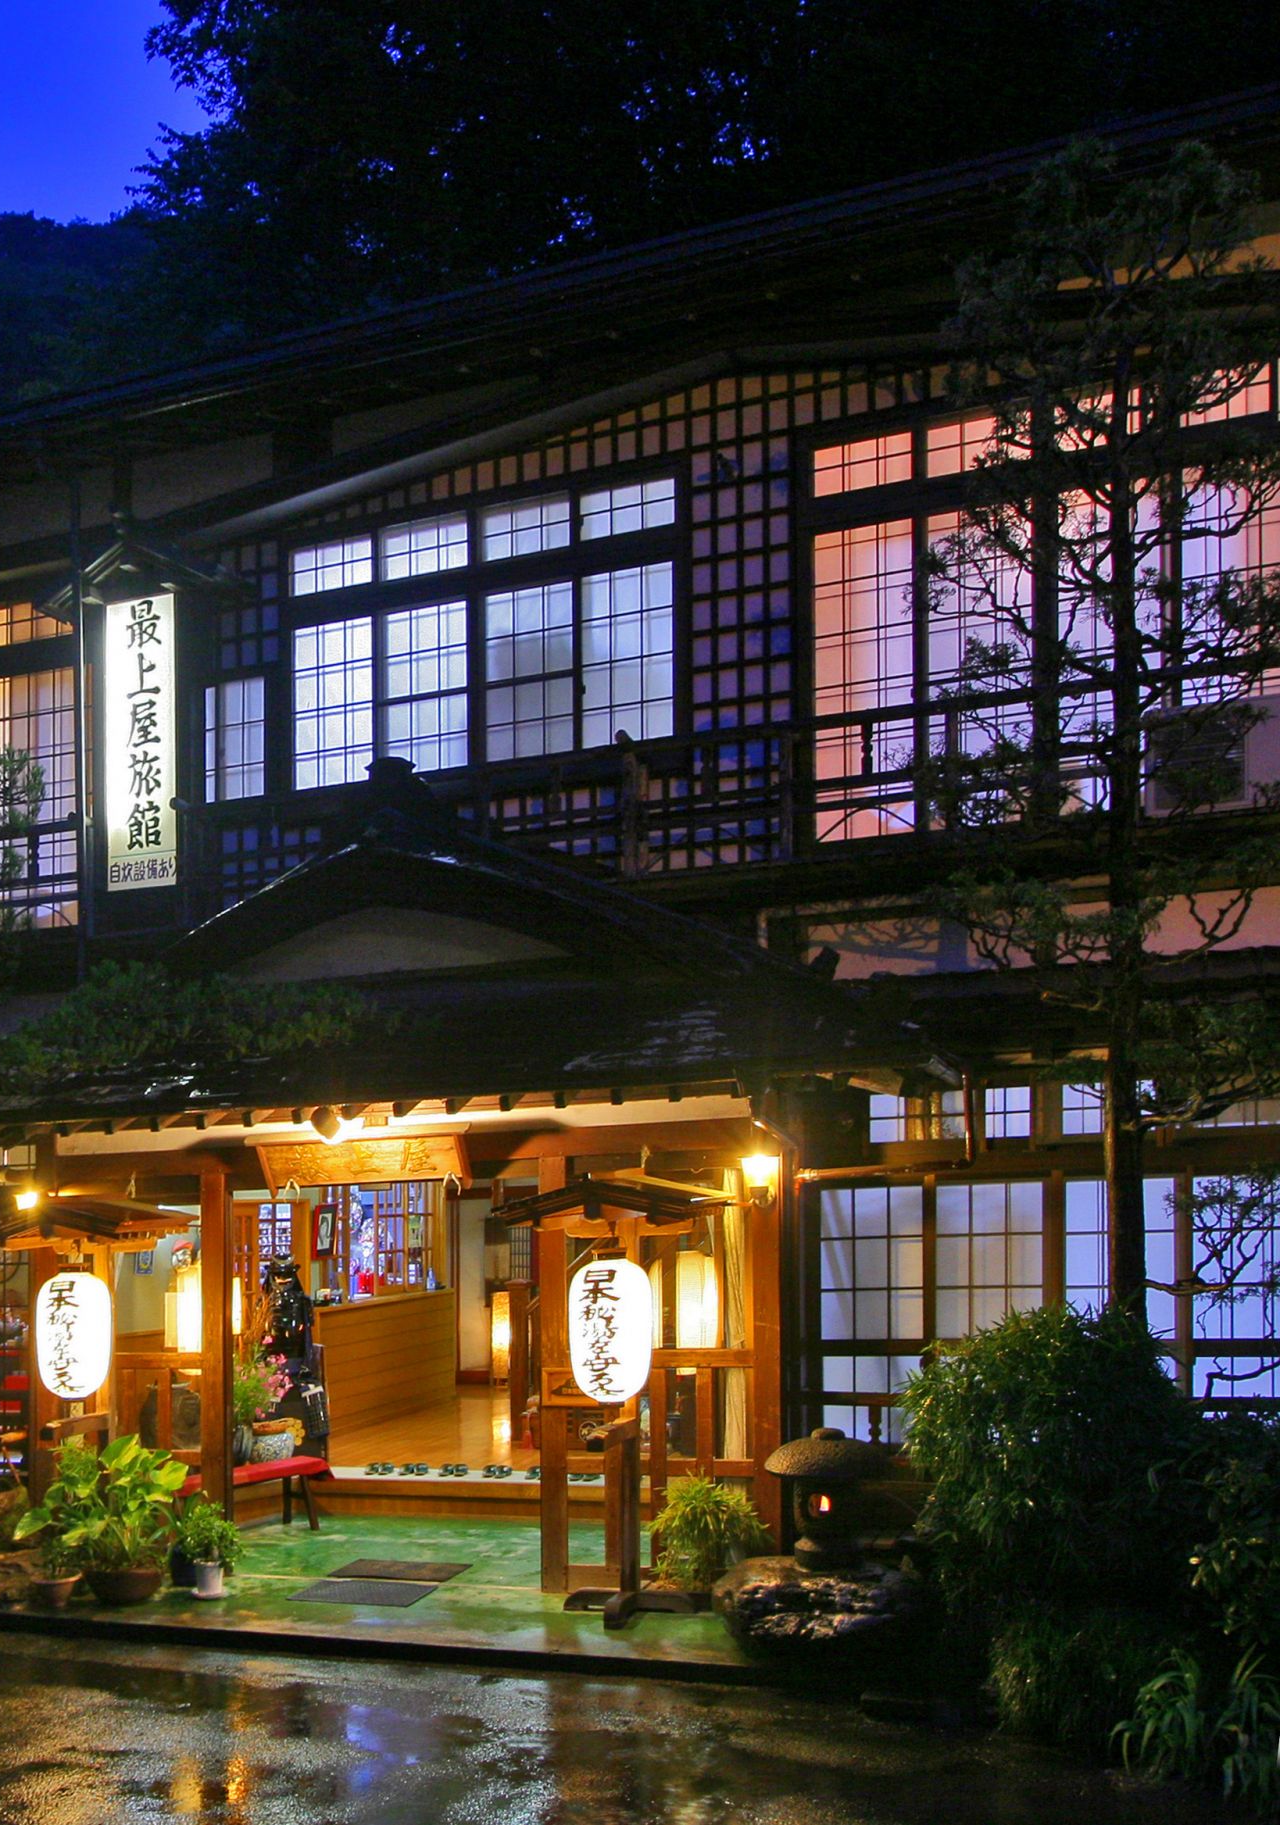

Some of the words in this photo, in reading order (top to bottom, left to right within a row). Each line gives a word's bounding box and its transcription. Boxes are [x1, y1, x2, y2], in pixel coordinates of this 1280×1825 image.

[126, 599, 162, 850] 最上屋旅館
[109, 856, 177, 884] 自炊設備あり
